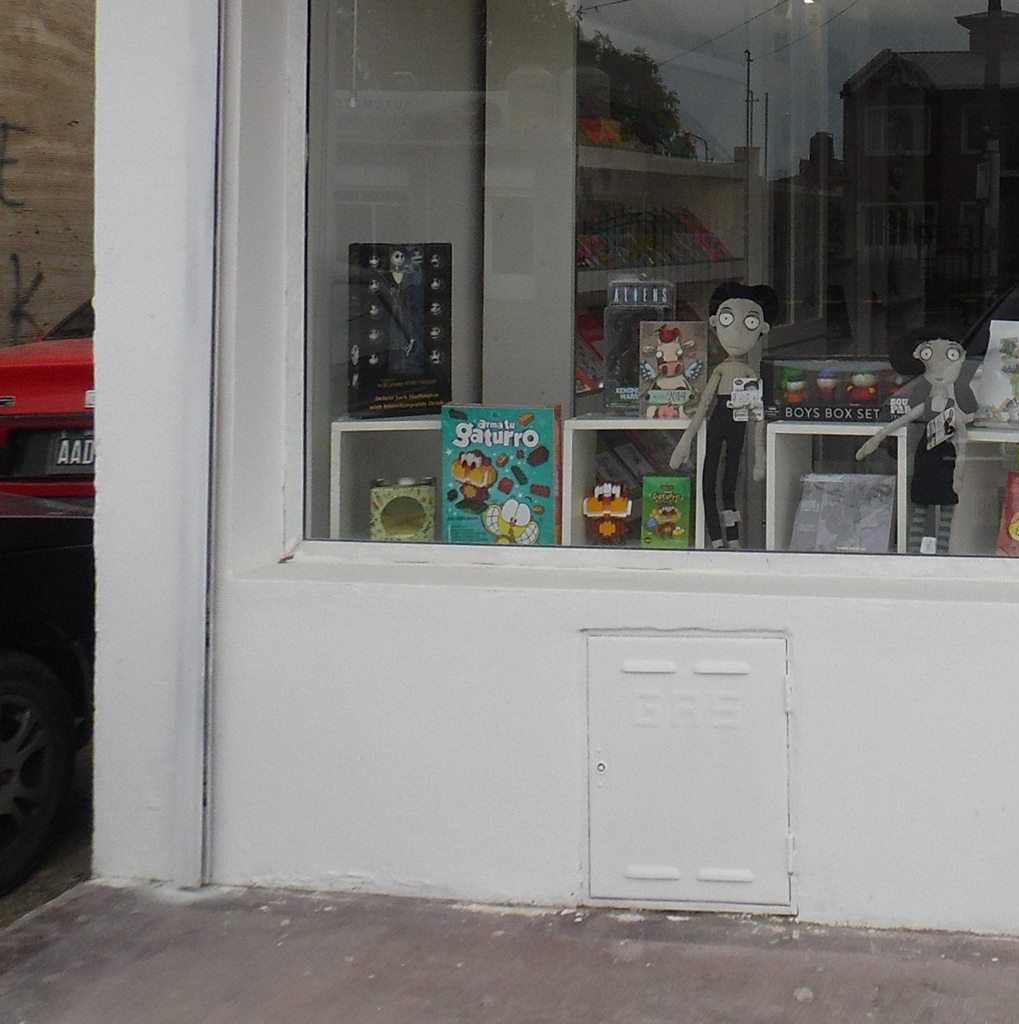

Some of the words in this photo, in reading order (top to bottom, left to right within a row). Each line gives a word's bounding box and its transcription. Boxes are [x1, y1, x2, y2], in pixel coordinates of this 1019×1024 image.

[613, 287, 667, 302] ALIENS
[785, 407, 820, 418] BOYS
[825, 408, 853, 419] BOX
[857, 408, 880, 419] SET
[477, 419, 503, 429] arma
[504, 419, 516, 429] tu
[452, 422, 540, 448] gaturro
